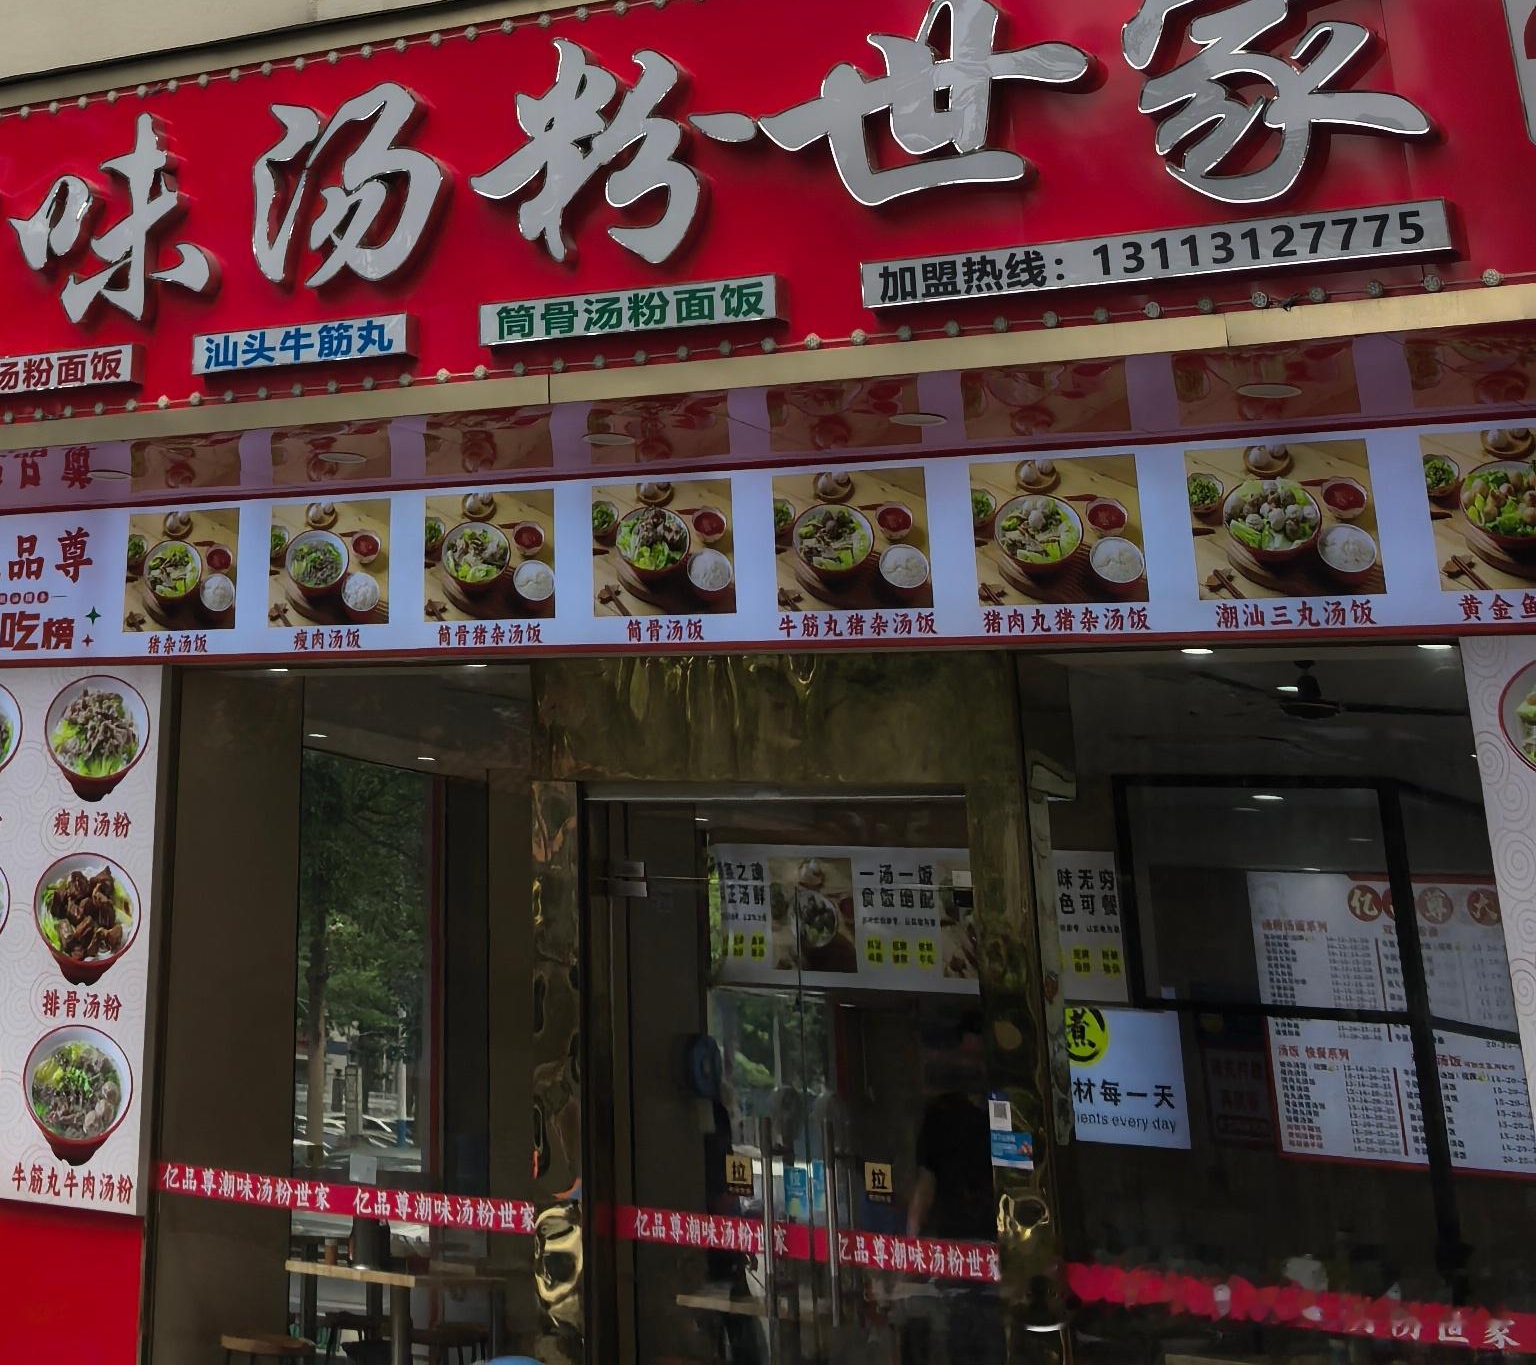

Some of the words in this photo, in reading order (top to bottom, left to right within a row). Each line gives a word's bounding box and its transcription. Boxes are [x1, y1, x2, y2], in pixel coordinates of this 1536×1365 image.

[496, 281, 765, 340] 筒骨汤粉面饭
[204, 319, 394, 370] 汕头牛筋丸
[779, 610, 939, 638] 牛筋丸猪杂汤饭
[984, 605, 1151, 635] 猪肉丸猪杂汤饭
[1215, 598, 1377, 629] 潮汕三丸汤饭
[148, 632, 209, 655] 猪杂汤饭
[293, 627, 362, 650] 瘦肉汤饭
[438, 622, 544, 646] 筒骨猪杂汤饭
[626, 618, 705, 642] 筒骨汤饭
[53, 811, 132, 838] 瘦肉汤粉
[859, 862, 933, 885] 一汤一饭
[1056, 868, 1115, 891] 味无穷
[42, 989, 123, 1022] 排骨汤粉
[1073, 1077, 1176, 1109] 材每一天
[1111, 1116, 1148, 1132] every
[1152, 1117, 1176, 1134] day
[11, 1163, 134, 1205] 牛筋丸牛肉汤粉
[871, 1168, 888, 1190] 拉
[163, 1163, 331, 1211] 亿品尊潮味汤粉世家
[353, 1186, 536, 1232] 亿品尊潮味汤粉世家
